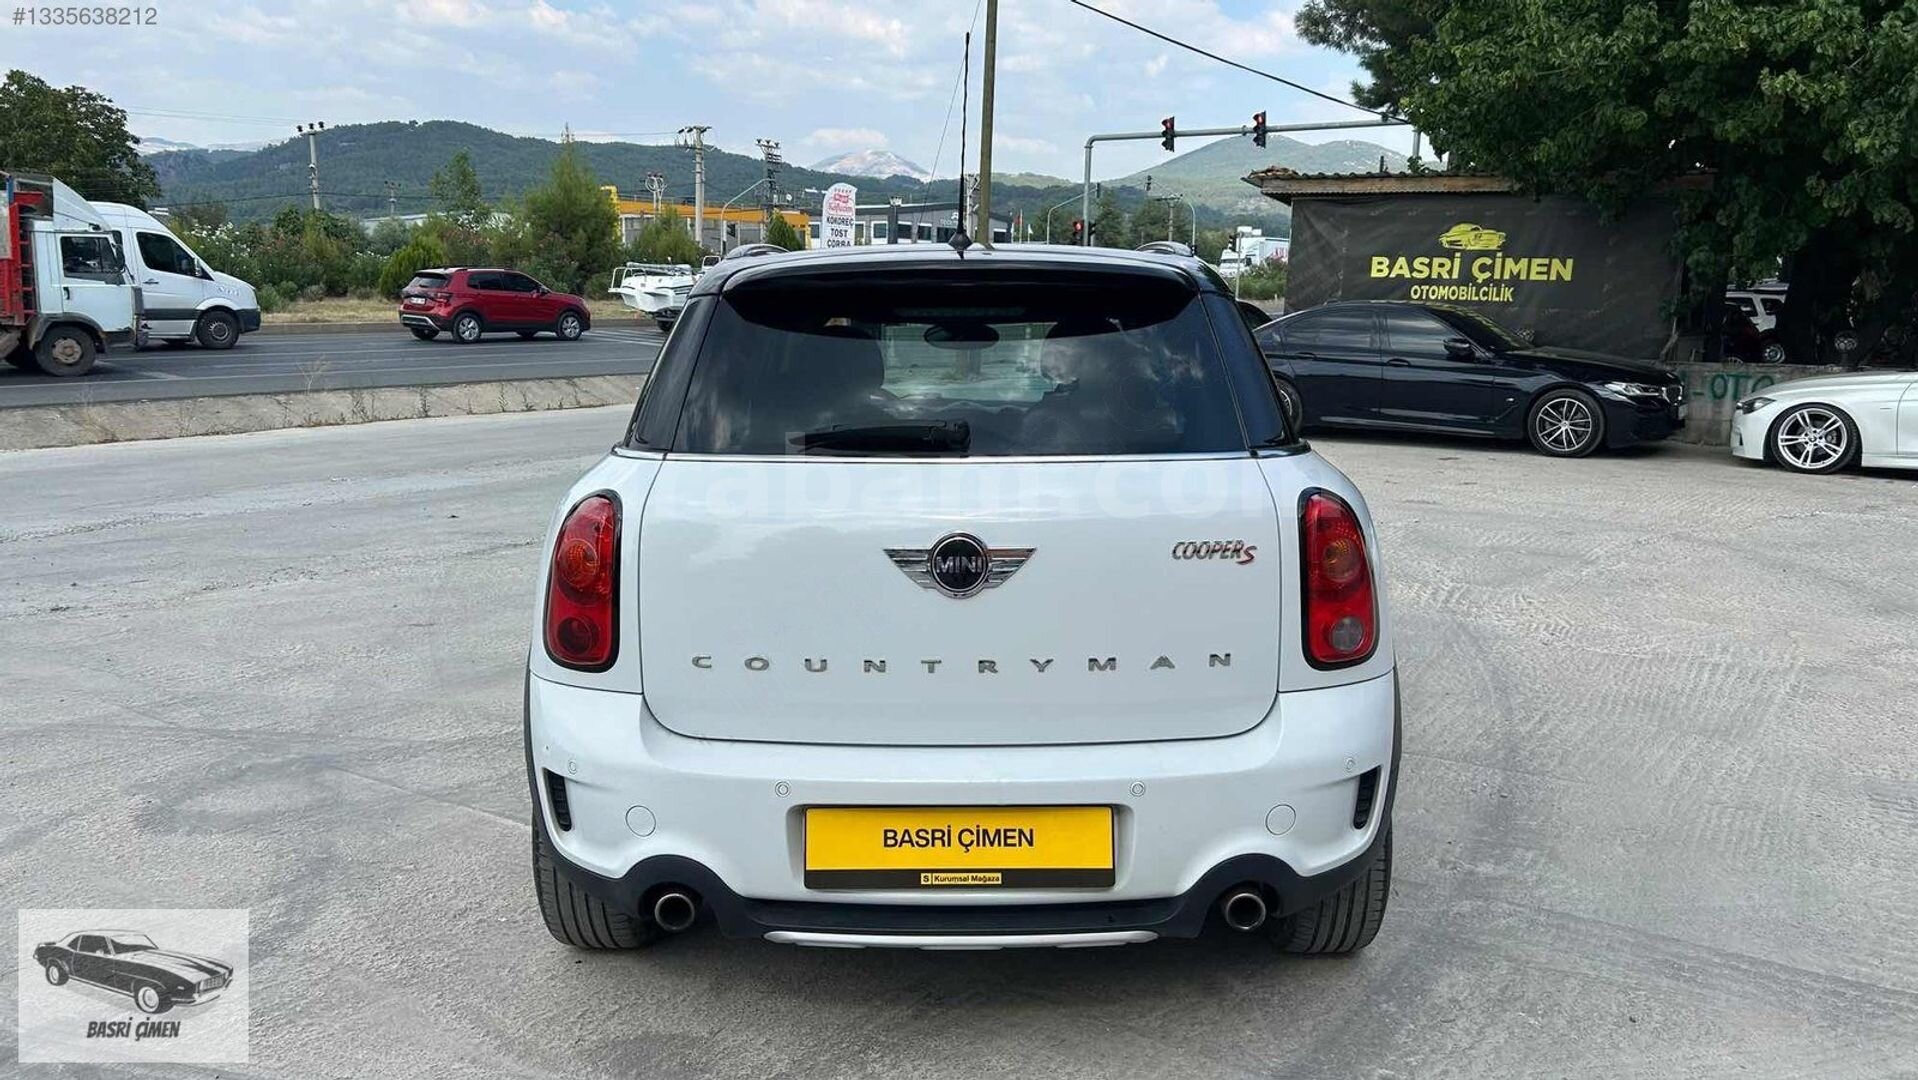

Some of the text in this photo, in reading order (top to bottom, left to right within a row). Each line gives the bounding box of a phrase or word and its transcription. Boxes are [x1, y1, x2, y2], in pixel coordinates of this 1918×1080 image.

[830, 228, 849, 238] TOST
[1370, 252, 1574, 283] BASRİ ÇİMEN
[1410, 283, 1515, 302] OTOMOBİLCİLİK
[935, 555, 983, 575] MINI
[691, 653, 1232, 673] COUNTRYMAN
[883, 825, 1034, 852] BASRİ ÇİMEN
[934, 875, 970, 883] Kurumsal
[971, 875, 1000, 883] Mağaza
